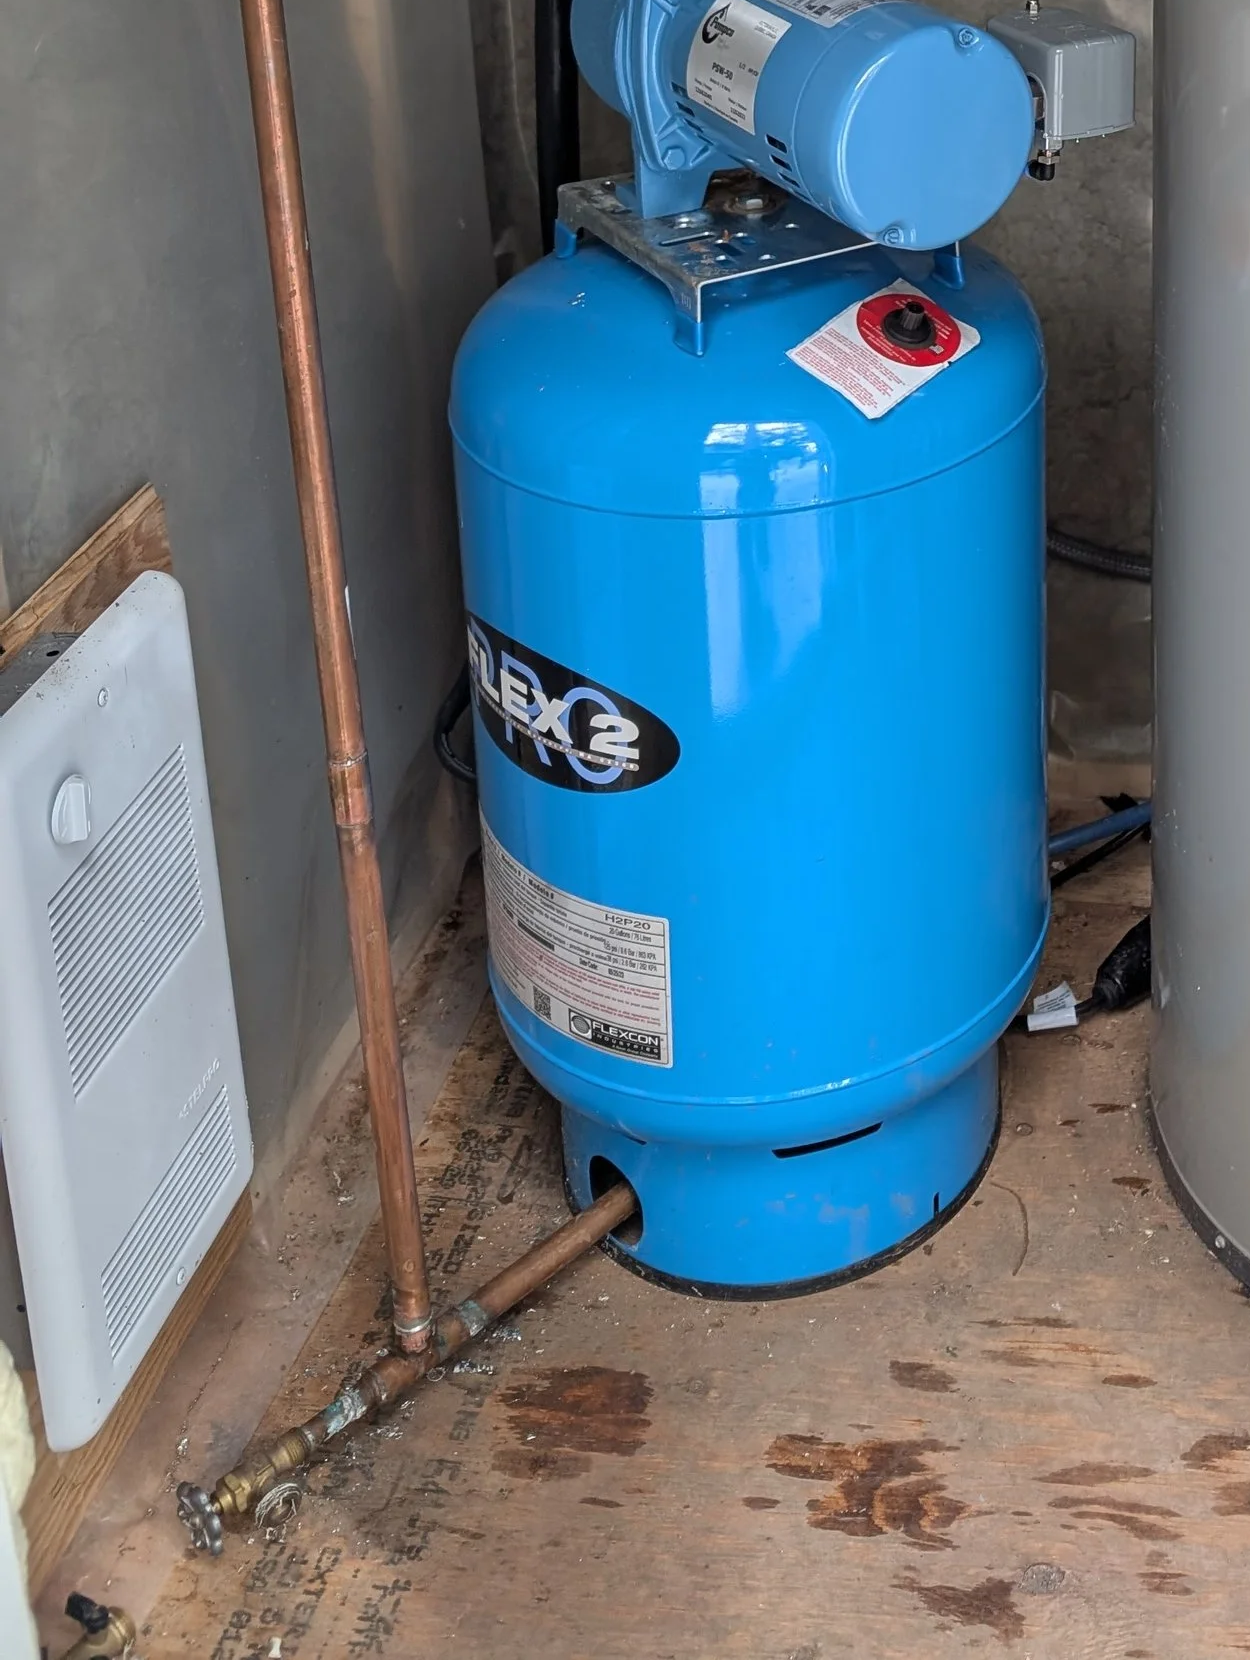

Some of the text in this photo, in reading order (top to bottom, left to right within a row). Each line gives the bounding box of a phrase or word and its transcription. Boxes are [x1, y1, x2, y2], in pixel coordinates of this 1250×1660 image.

[708, 15, 737, 40] Pompco
[470, 631, 641, 760] FLEX 2
[604, 913, 651, 930] H2P20
[590, 1020, 660, 1046] FLEXCON
[591, 1032, 659, 1053] INDUSTRIES
